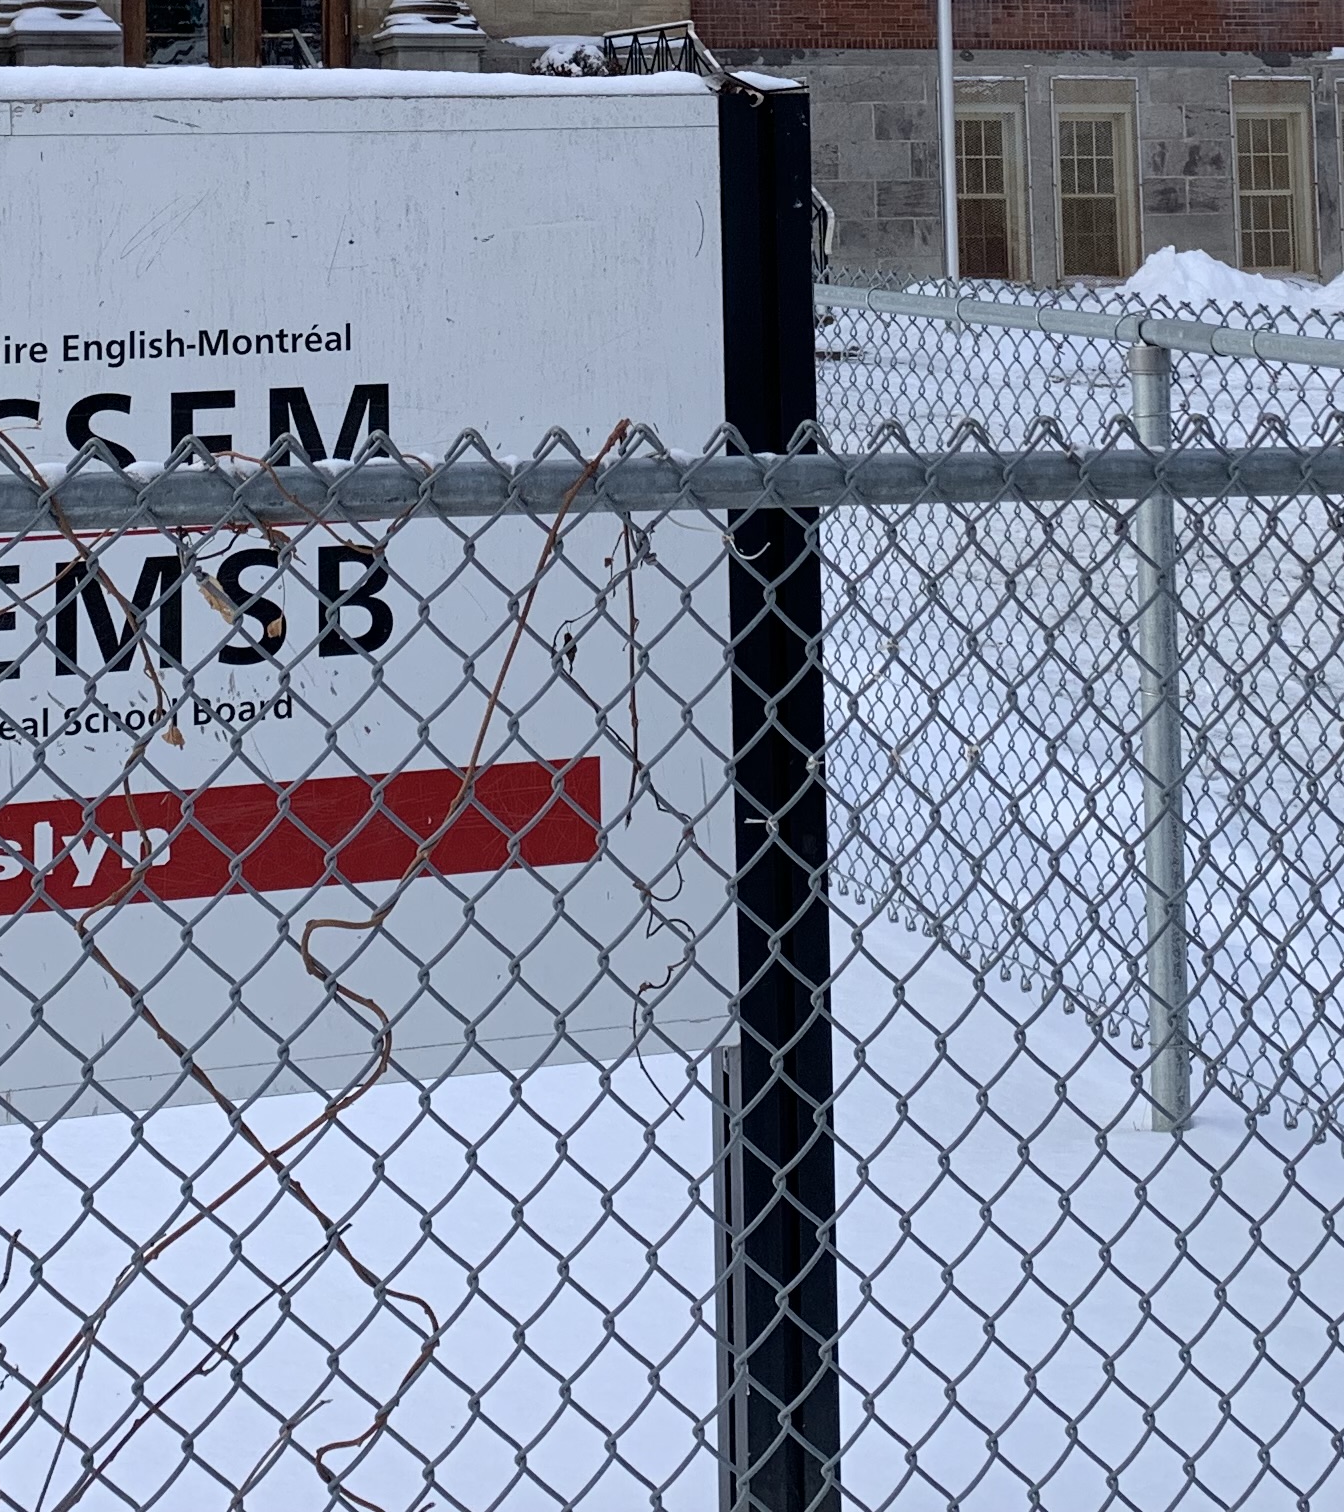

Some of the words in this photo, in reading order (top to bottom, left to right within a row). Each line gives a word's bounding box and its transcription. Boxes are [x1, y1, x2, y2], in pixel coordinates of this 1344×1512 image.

[62, 322, 353, 368] English-Montréal
[63, 697, 179, 736] School
[193, 691, 294, 726] Board
